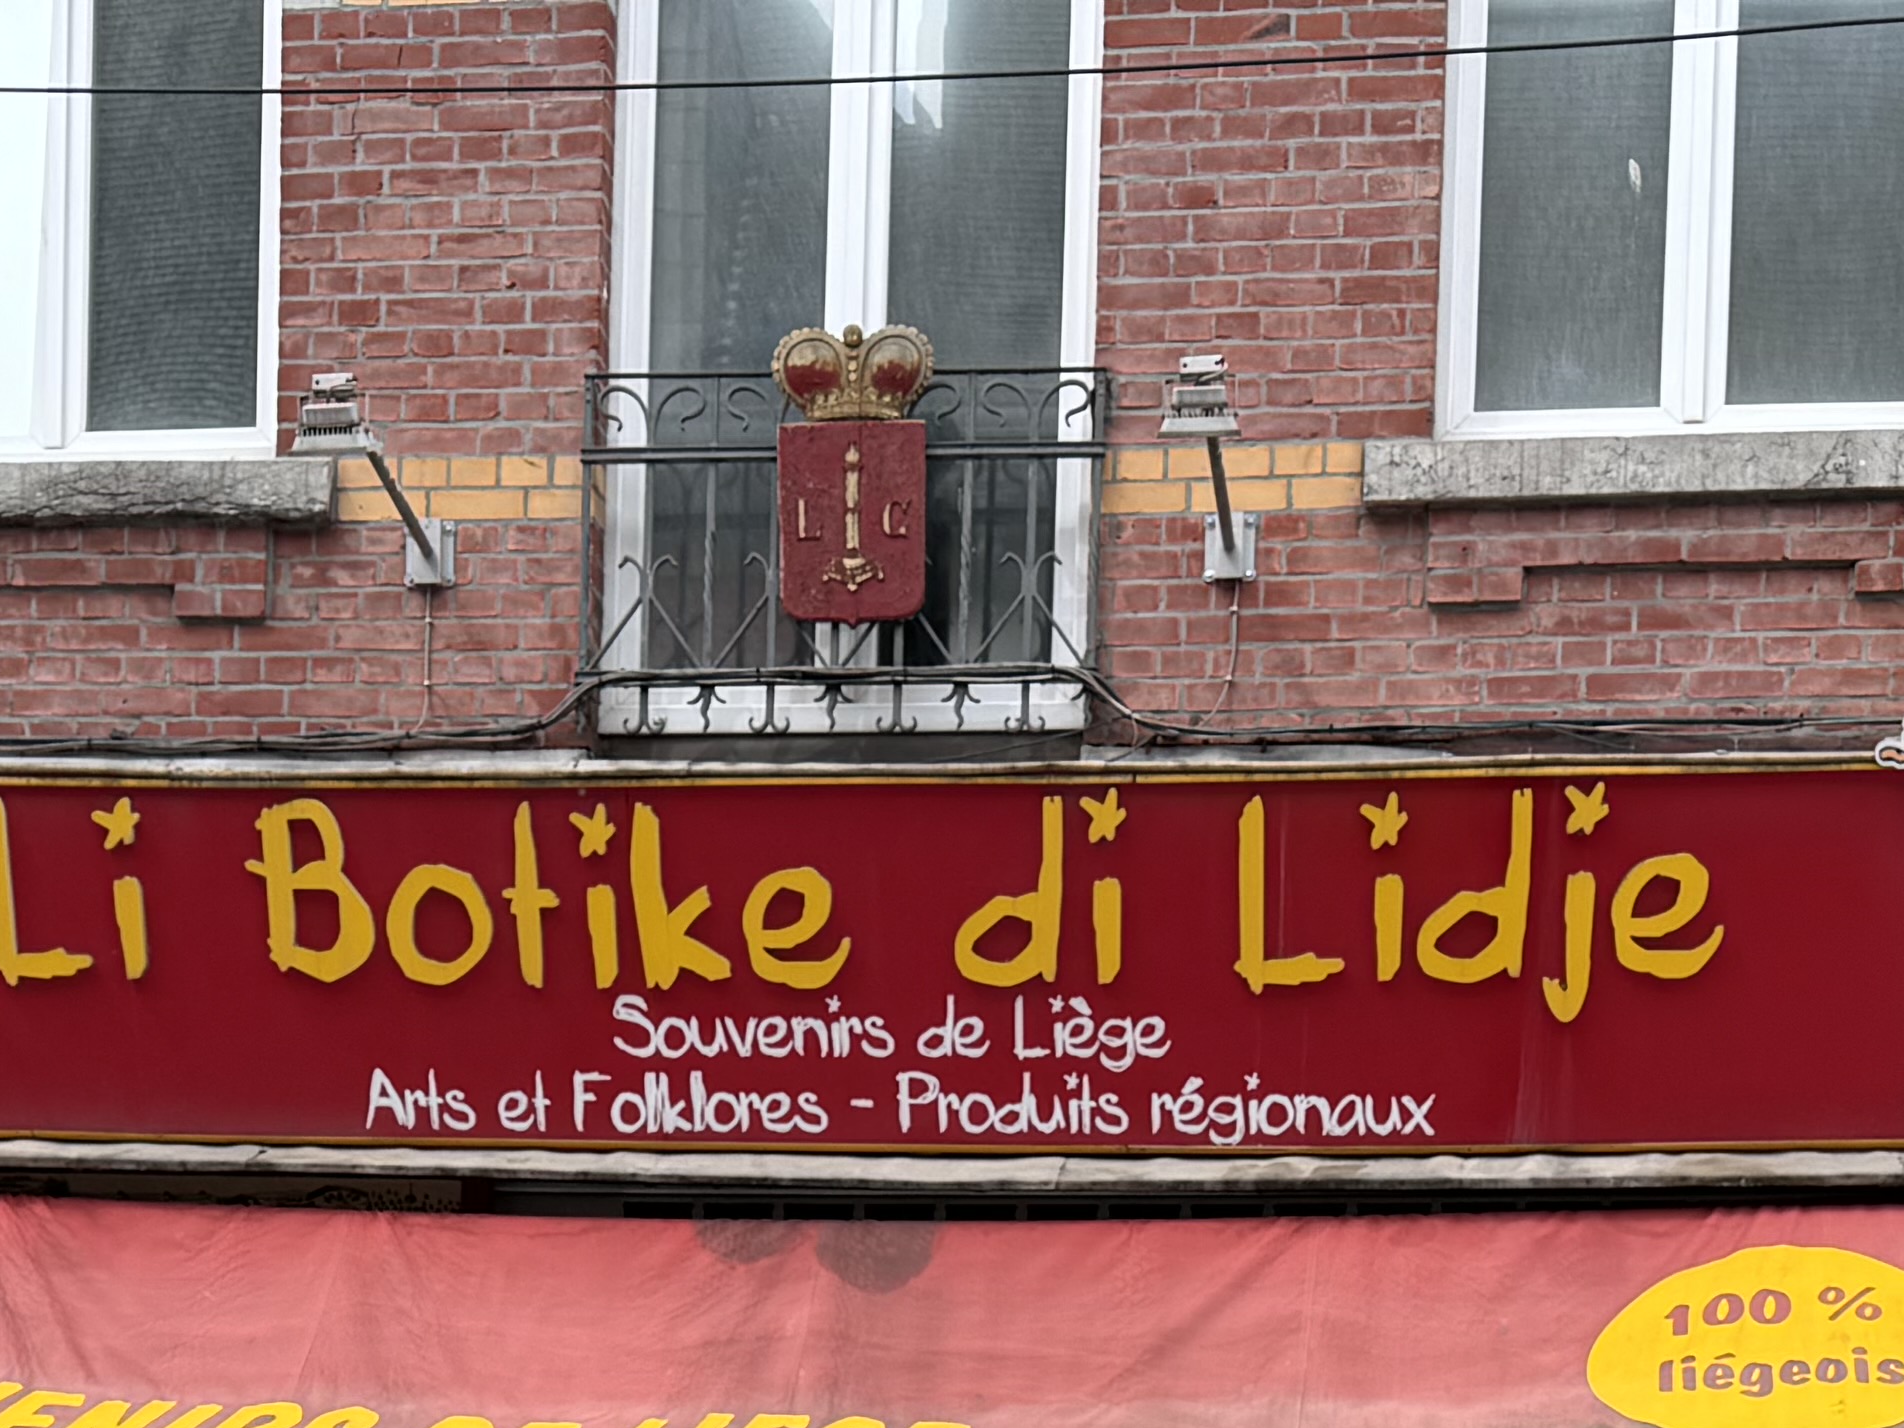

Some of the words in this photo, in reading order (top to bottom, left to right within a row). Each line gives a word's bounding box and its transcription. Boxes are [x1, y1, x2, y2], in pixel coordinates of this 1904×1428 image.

[244, 797, 852, 990] Botike
[953, 787, 1127, 989] di
[1232, 780, 1725, 1023] Lidje
[612, 994, 895, 1059] Souvenirs
[916, 994, 990, 1059] de
[1013, 994, 1172, 1072] Liège
[365, 1067, 477, 1131] Arts
[497, 1070, 551, 1132] et
[572, 1070, 829, 1134] Folklores
[895, 1069, 1130, 1135] Produits
[1150, 1072, 1436, 1146] régionaux
[1662, 1287, 1793, 1337] 100
[1816, 1286, 1884, 1322] %
